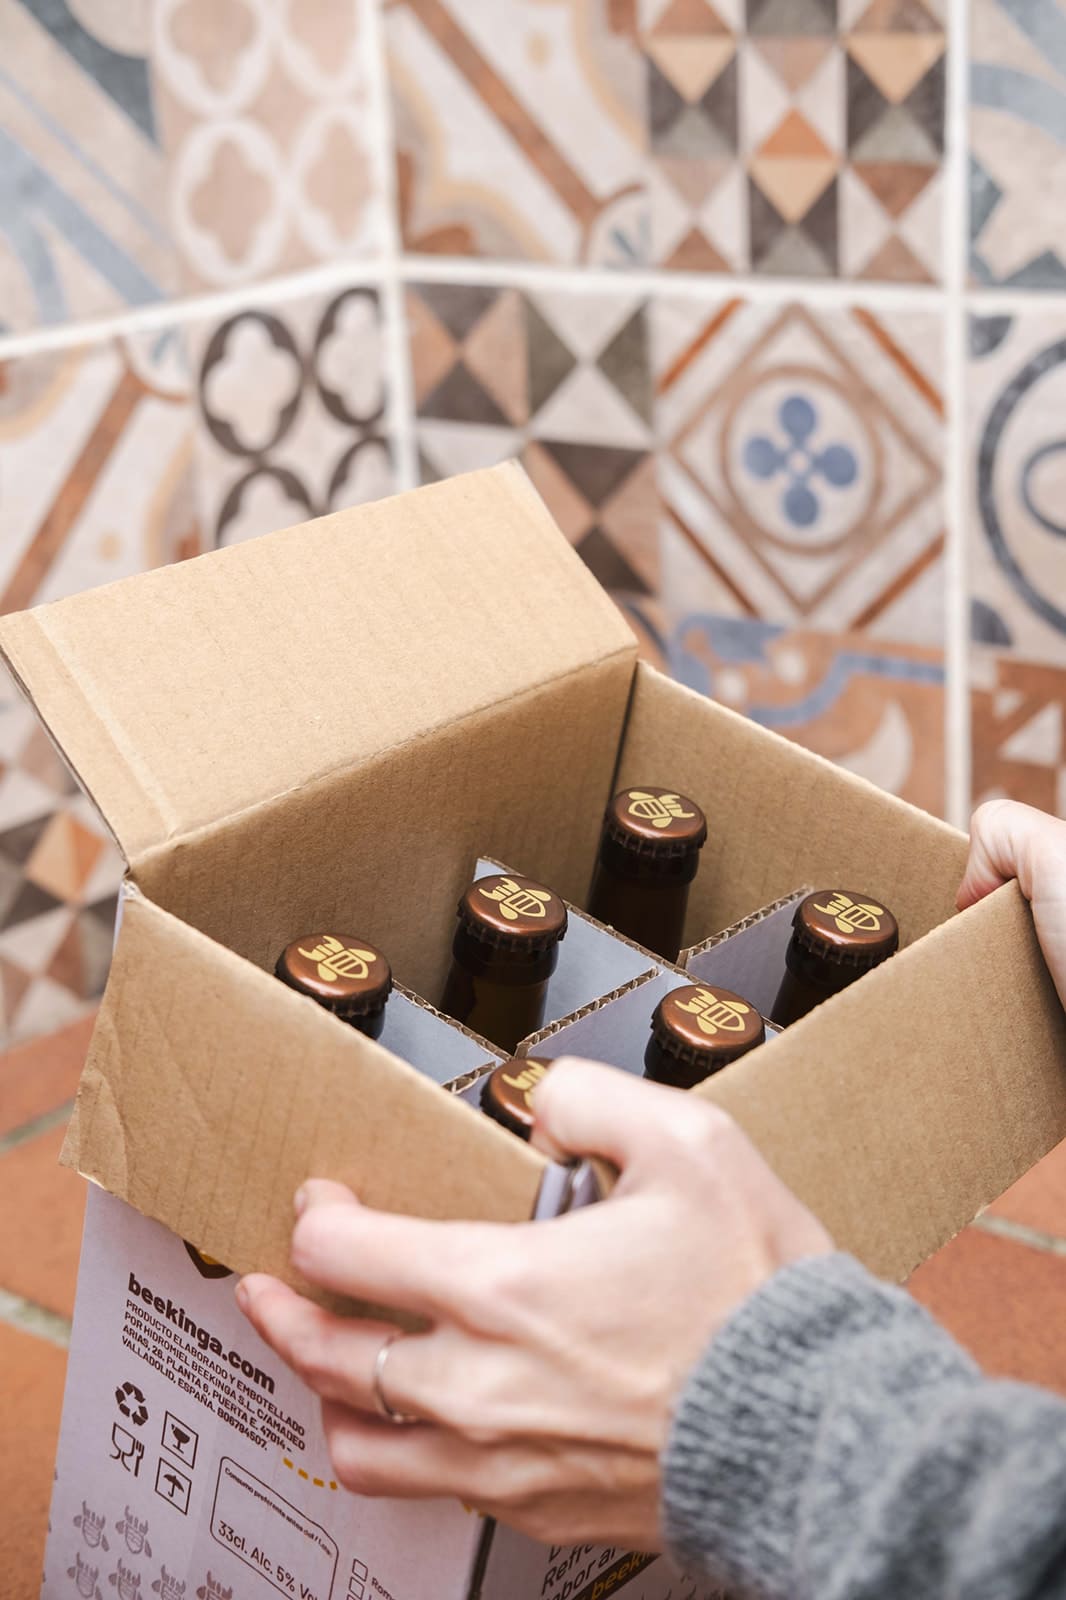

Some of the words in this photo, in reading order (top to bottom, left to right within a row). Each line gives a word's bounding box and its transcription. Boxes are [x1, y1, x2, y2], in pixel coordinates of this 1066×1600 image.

[125, 1311, 143, 1330] POR
[143, 1325, 190, 1366] HIDROMIEL
[191, 1360, 236, 1400] BEEKINGA
[256, 1408, 305, 1450] C/AMADEO
[126, 1299, 172, 1338] PRODUCTO
[173, 1333, 228, 1379] ELABORADO
[229, 1373, 236, 1384] Y
[236, 1380, 305, 1436] EMBOTELLADO
[128, 1272, 275, 1394] beekinga.com
[166, 1356, 201, 1388] PLANTA
[212, 1390, 248, 1422] PUERTA
[218, 1520, 248, 1554] 33cl.
[250, 1547, 273, 1575] Alc.
[276, 1565, 295, 1592] 5%
